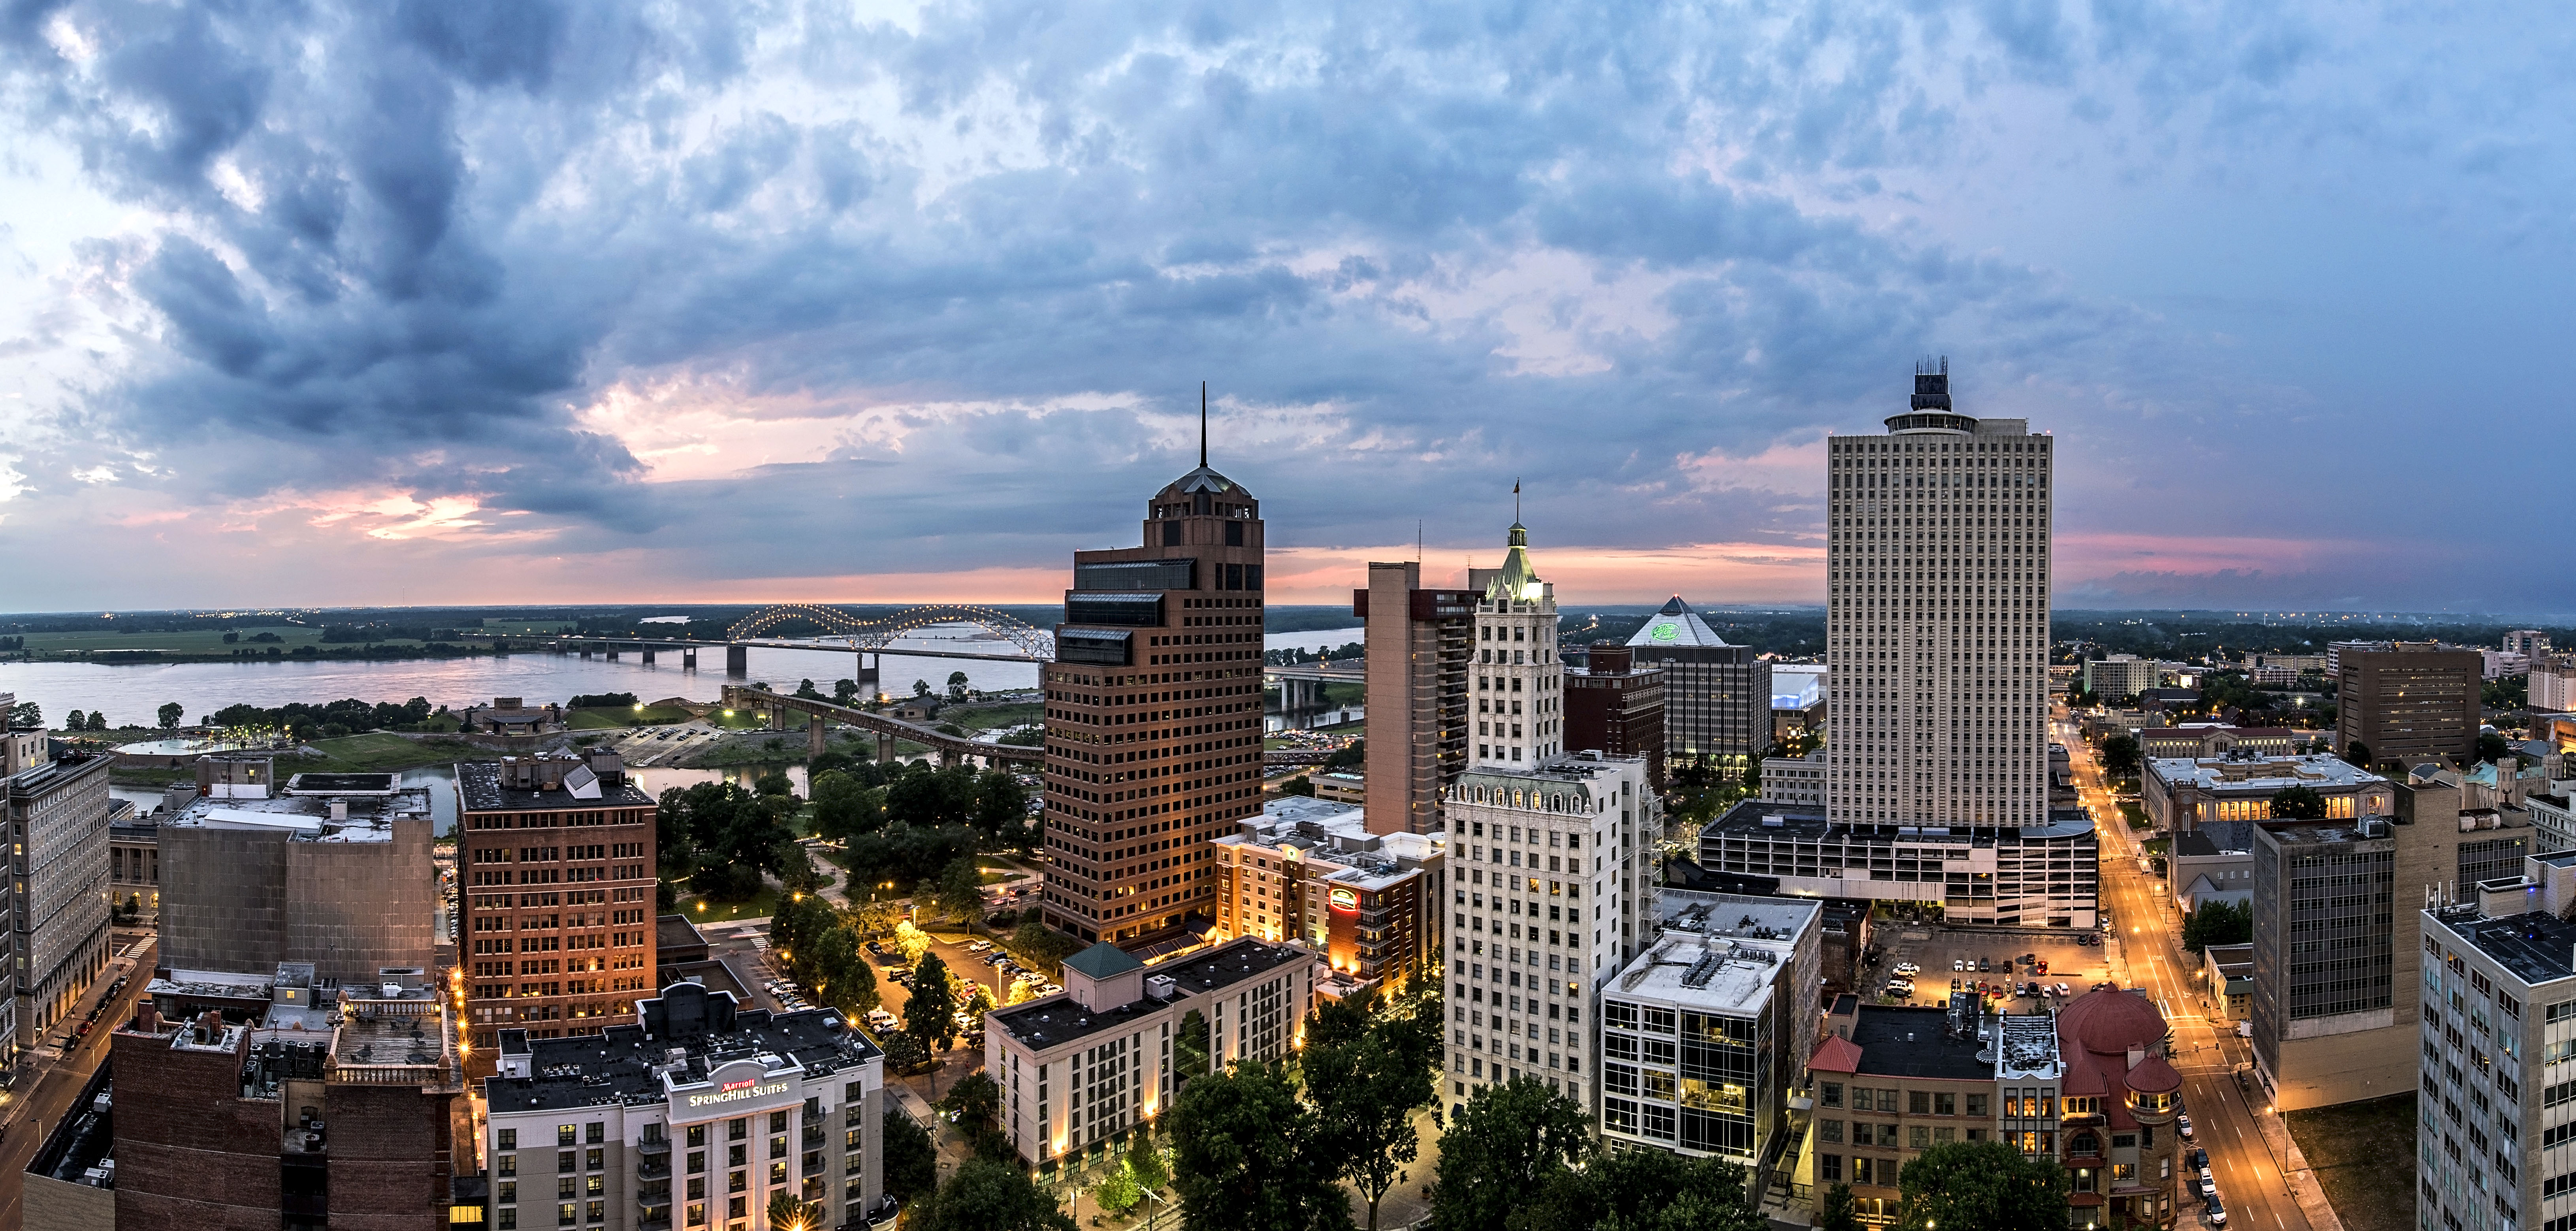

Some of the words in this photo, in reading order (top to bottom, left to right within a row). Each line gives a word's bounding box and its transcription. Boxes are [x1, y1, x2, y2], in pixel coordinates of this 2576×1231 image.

[721, 1079, 755, 1092] Marriott
[690, 1090, 751, 1107] SPRINGHILL
[753, 1083, 787, 1097] SUITES
